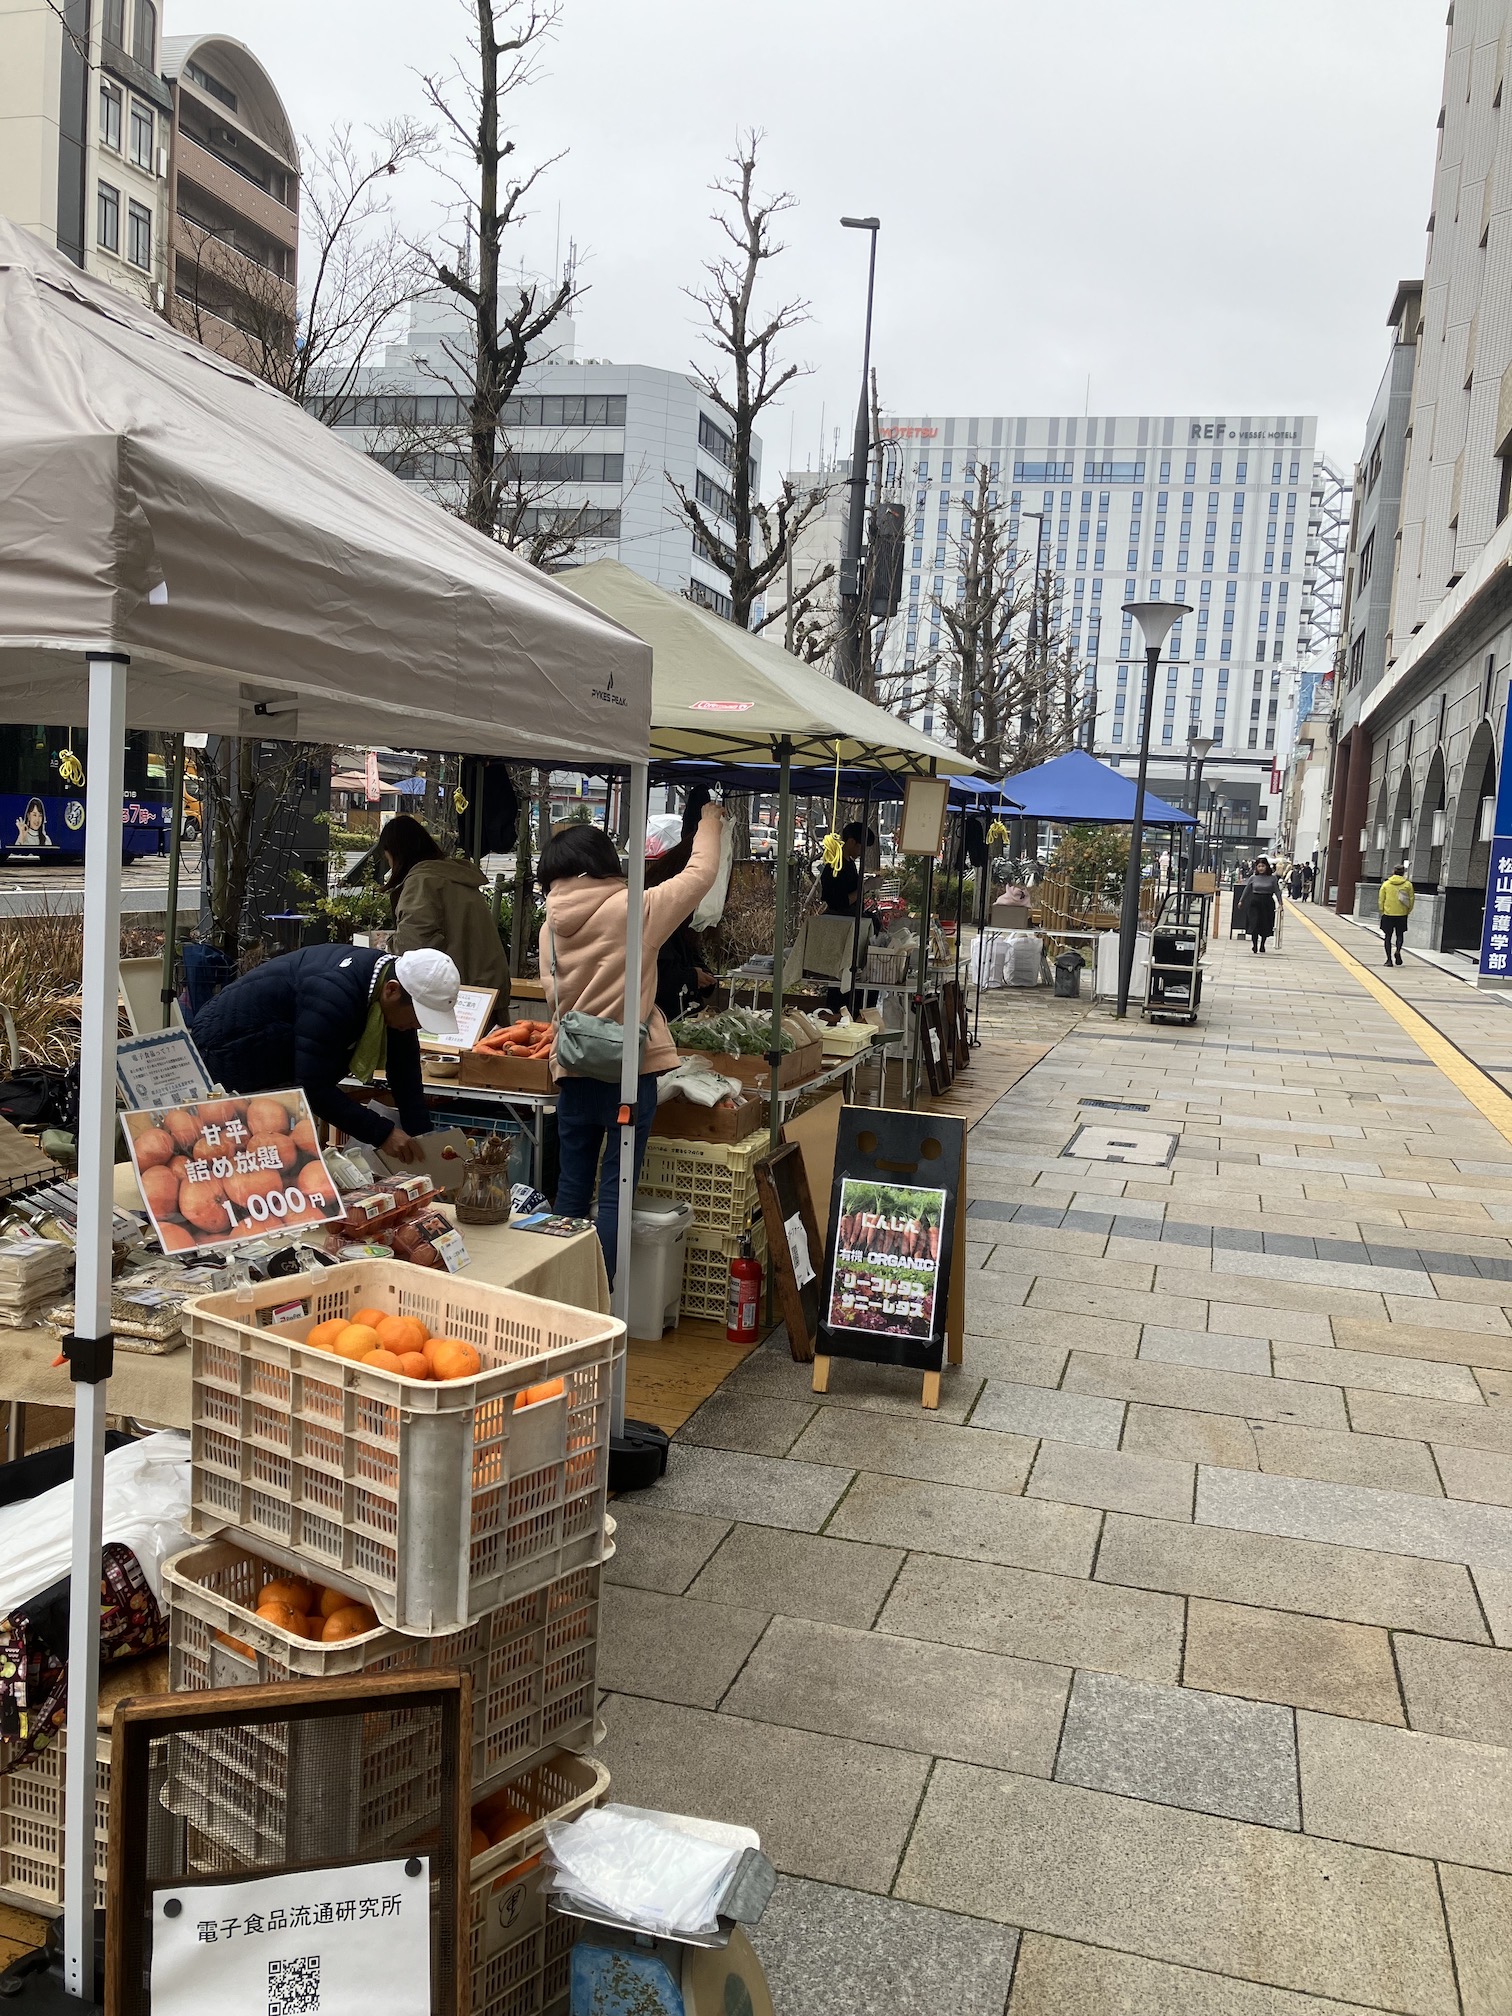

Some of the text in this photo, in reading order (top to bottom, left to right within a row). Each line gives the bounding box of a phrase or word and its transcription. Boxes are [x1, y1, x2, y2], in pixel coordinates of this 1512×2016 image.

[1191, 423, 1226, 439] REF
[1240, 431, 1266, 439] VESSEL
[1268, 431, 1297, 439] HOTELS
[592, 689, 611, 703] PYKES
[1488, 857, 1512, 971] 松山看護学部
[201, 1119, 248, 1147] 甘平
[184, 1145, 283, 1184] 詰め放題
[221, 1186, 326, 1229] 1,000円
[862, 1212, 920, 1234] にんじん
[839, 1248, 934, 1272] 有機 ORGANIC
[843, 1273, 926, 1298] リーフレタス
[841, 1293, 925, 1318] サニーレタス
[197, 1893, 402, 1943] 電子食品流通研究所
